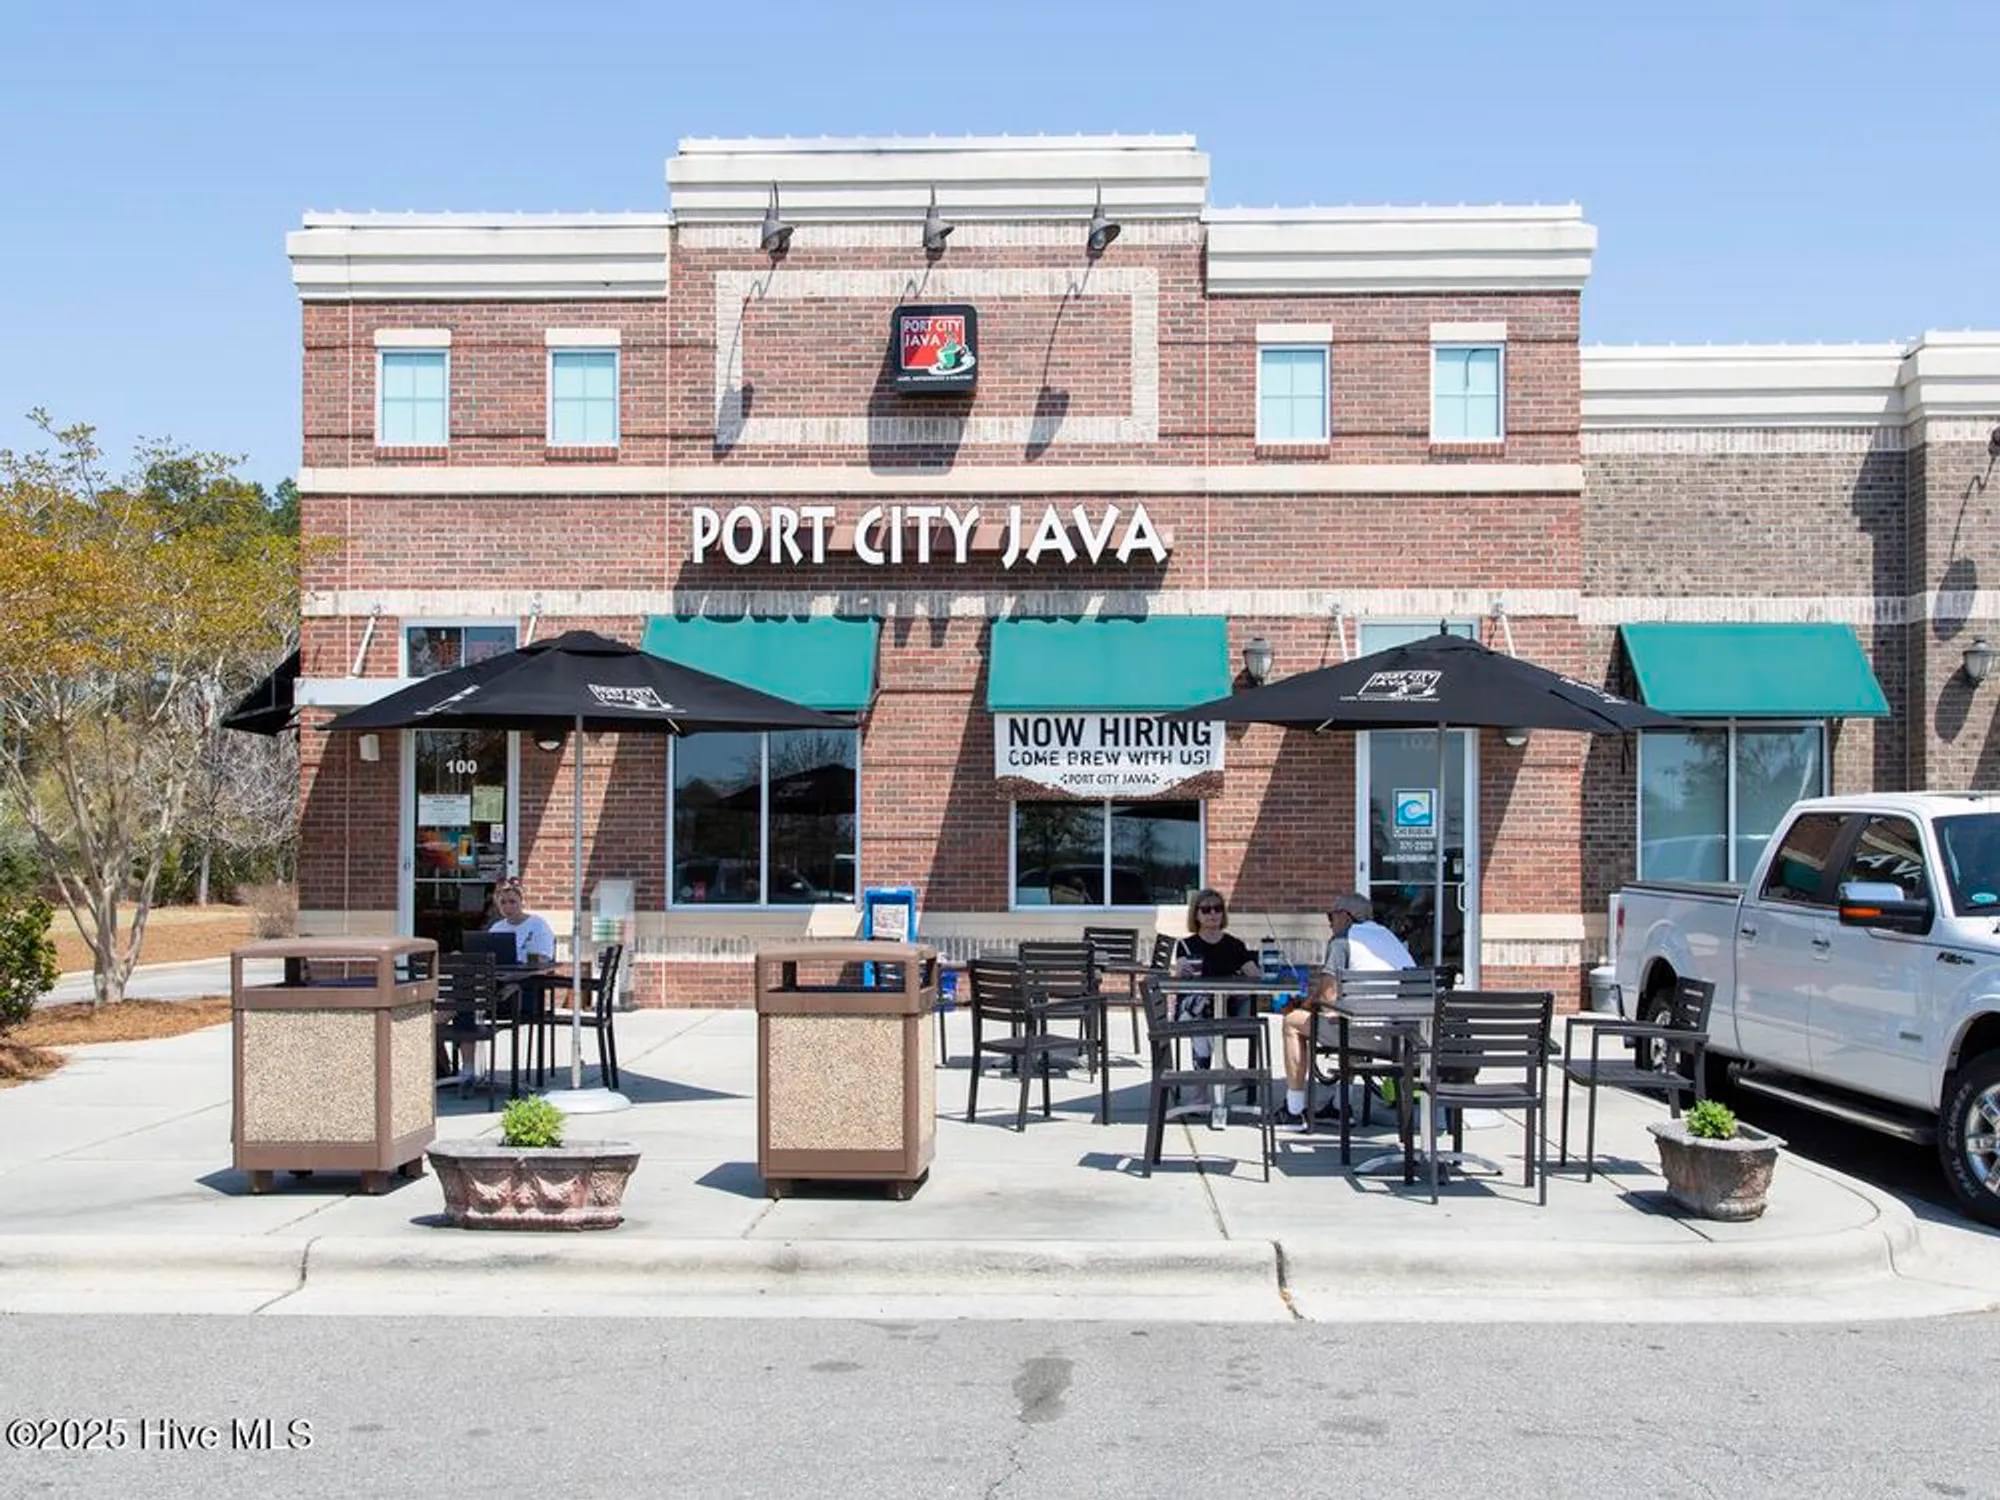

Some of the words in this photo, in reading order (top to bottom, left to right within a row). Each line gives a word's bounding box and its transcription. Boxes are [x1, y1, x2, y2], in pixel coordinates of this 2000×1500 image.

[903, 320, 932, 331] PORT
[936, 320, 961, 331] CITY
[904, 334, 941, 347] JAVA
[692, 505, 835, 566] PORT
[853, 505, 980, 566] CITY
[1001, 503, 1167, 569] JAVA
[1009, 718, 1085, 747] NOW
[1100, 718, 1211, 747] HIRING
[1009, 750, 1059, 766] COME
[1068, 750, 1121, 766] BREW
[1127, 750, 1172, 766] WITH
[1180, 750, 1211, 766] US!
[446, 760, 478, 774] 100
[1069, 774, 1095, 785] PORT
[1096, 774, 1119, 785] CITY
[1122, 774, 1150, 785] JAVA
